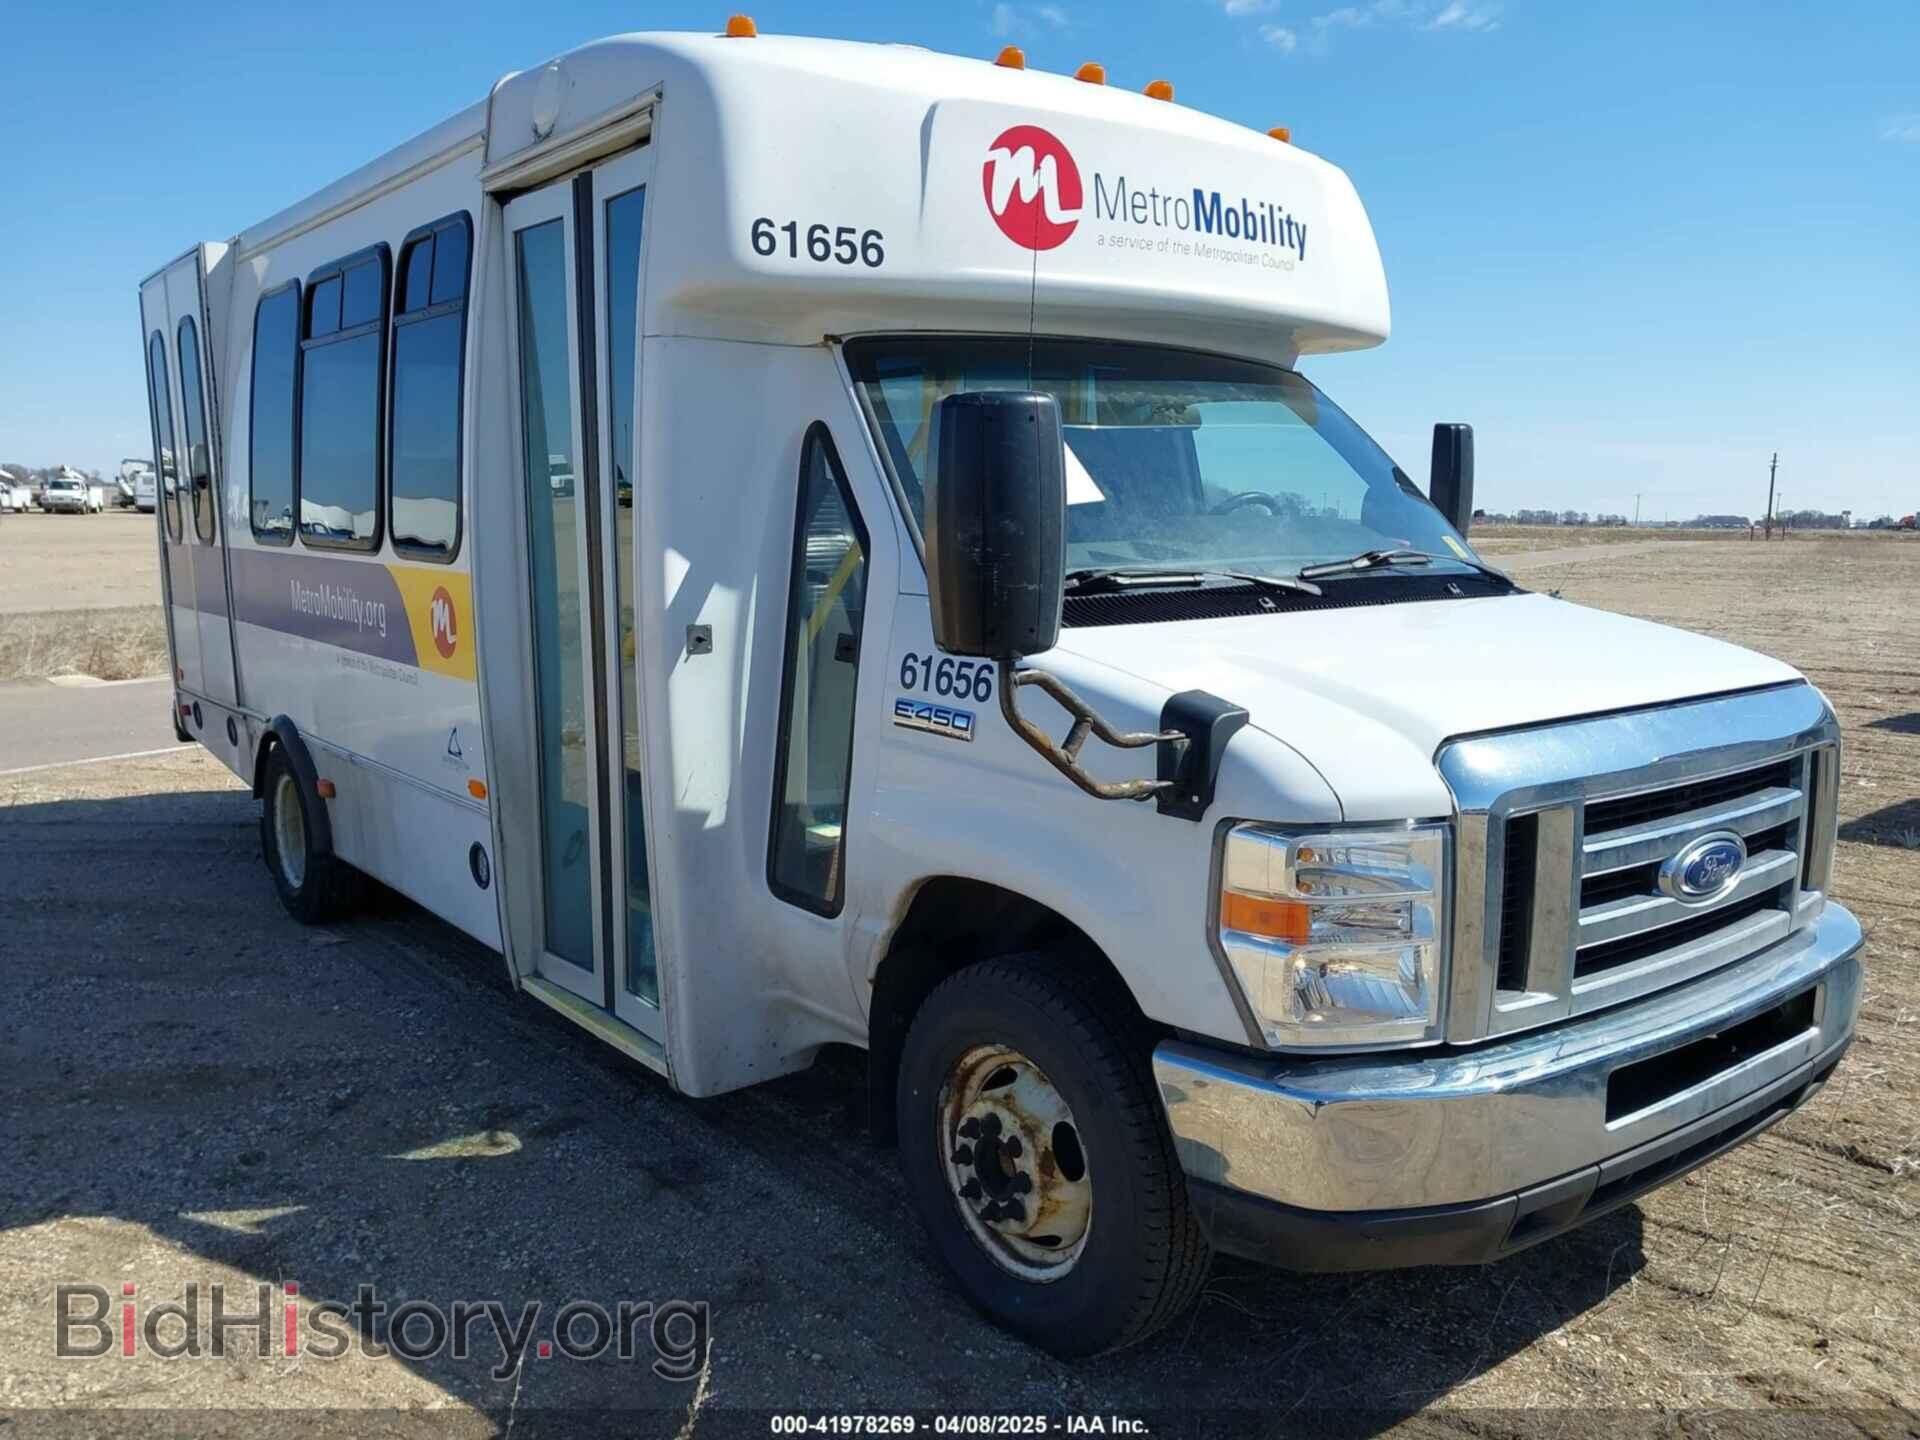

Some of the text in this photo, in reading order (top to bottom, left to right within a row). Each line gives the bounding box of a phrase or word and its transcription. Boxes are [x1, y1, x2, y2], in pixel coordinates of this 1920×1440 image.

[751, 217, 885, 268] 61656
[1094, 172, 1307, 262] MetroMobility
[1097, 233, 1295, 272] a service of the Metropolitan Council
[289, 579, 387, 638] MetroMobility.org
[900, 652, 995, 703] 61656
[1699, 851, 1736, 883] Ford
